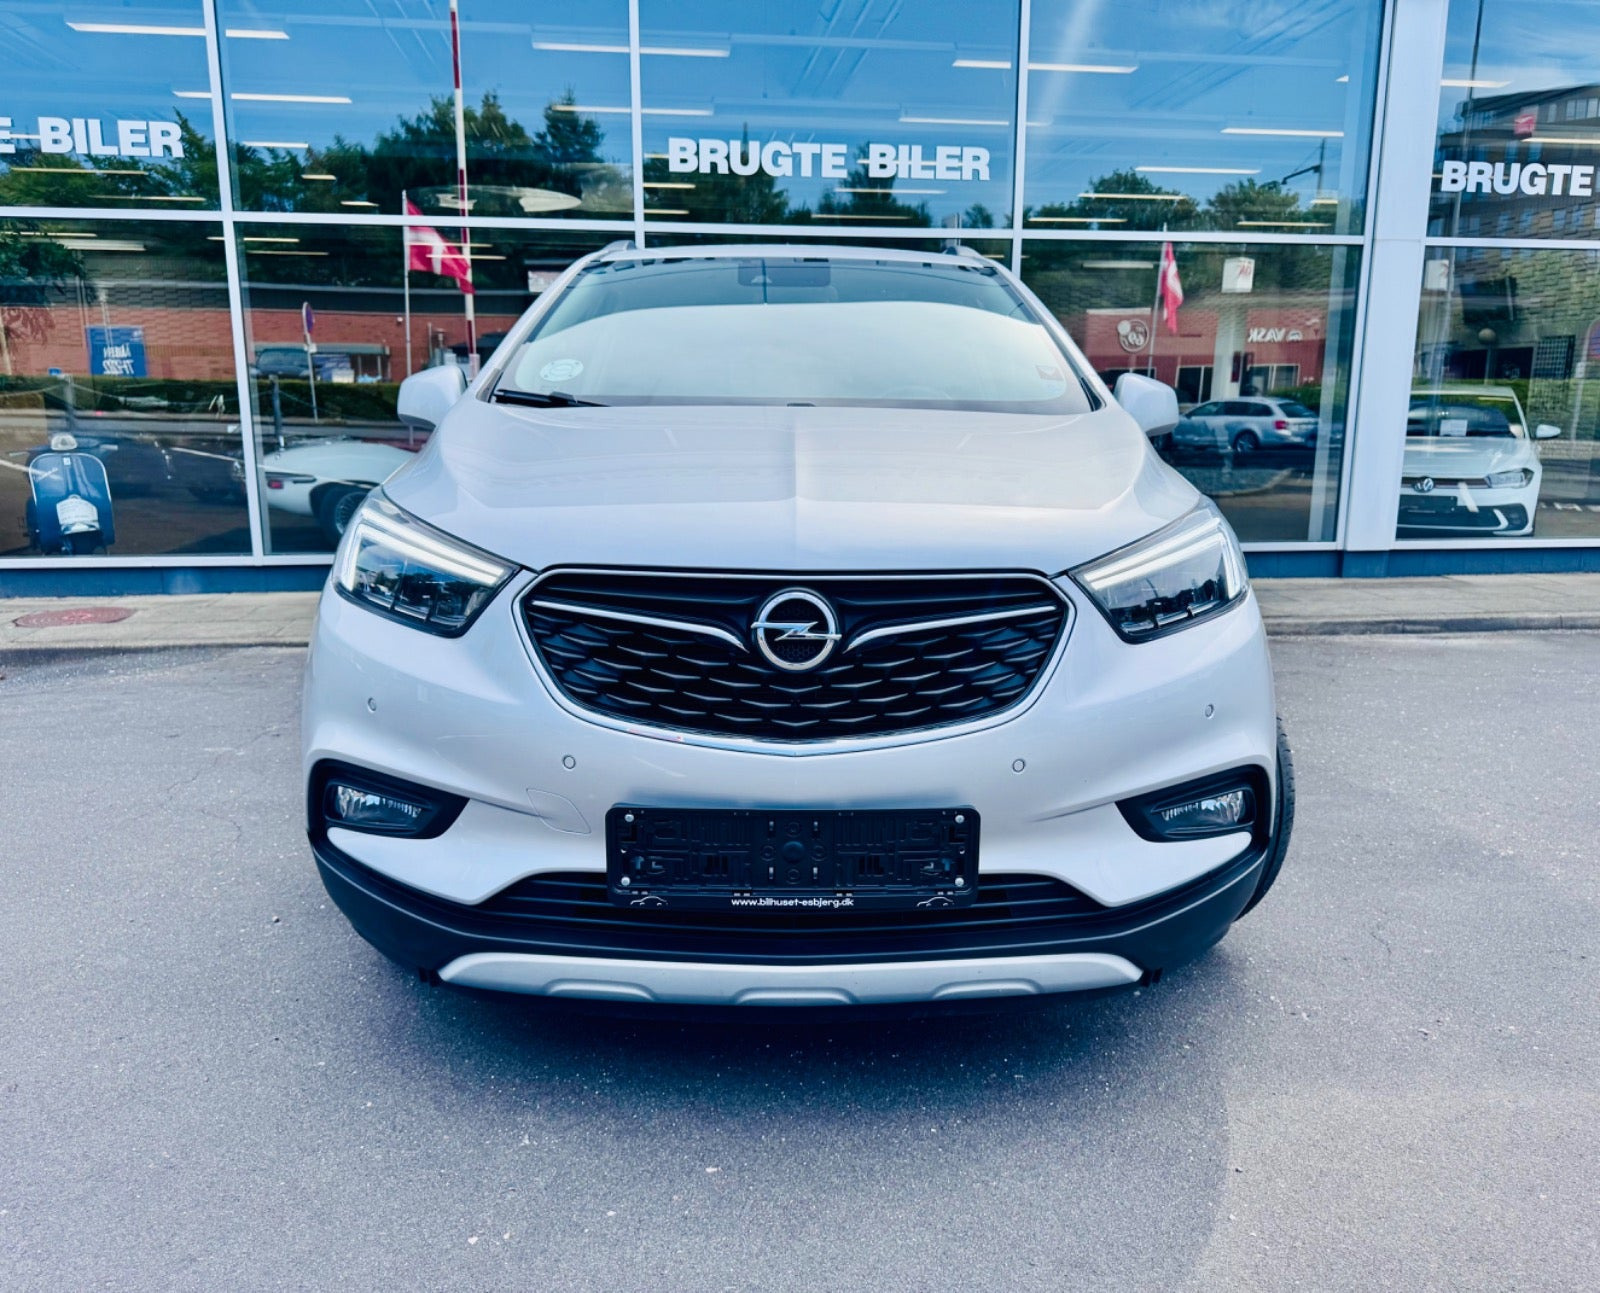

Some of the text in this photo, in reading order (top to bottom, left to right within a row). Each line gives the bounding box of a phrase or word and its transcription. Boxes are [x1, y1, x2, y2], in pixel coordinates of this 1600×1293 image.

[37, 116, 186, 158] BILER
[668, 137, 991, 181] BRUGTE BILER
[1441, 160, 1594, 197] BRUGTE
[731, 898, 854, 908] www.bilhuset-esbjerg.dk
